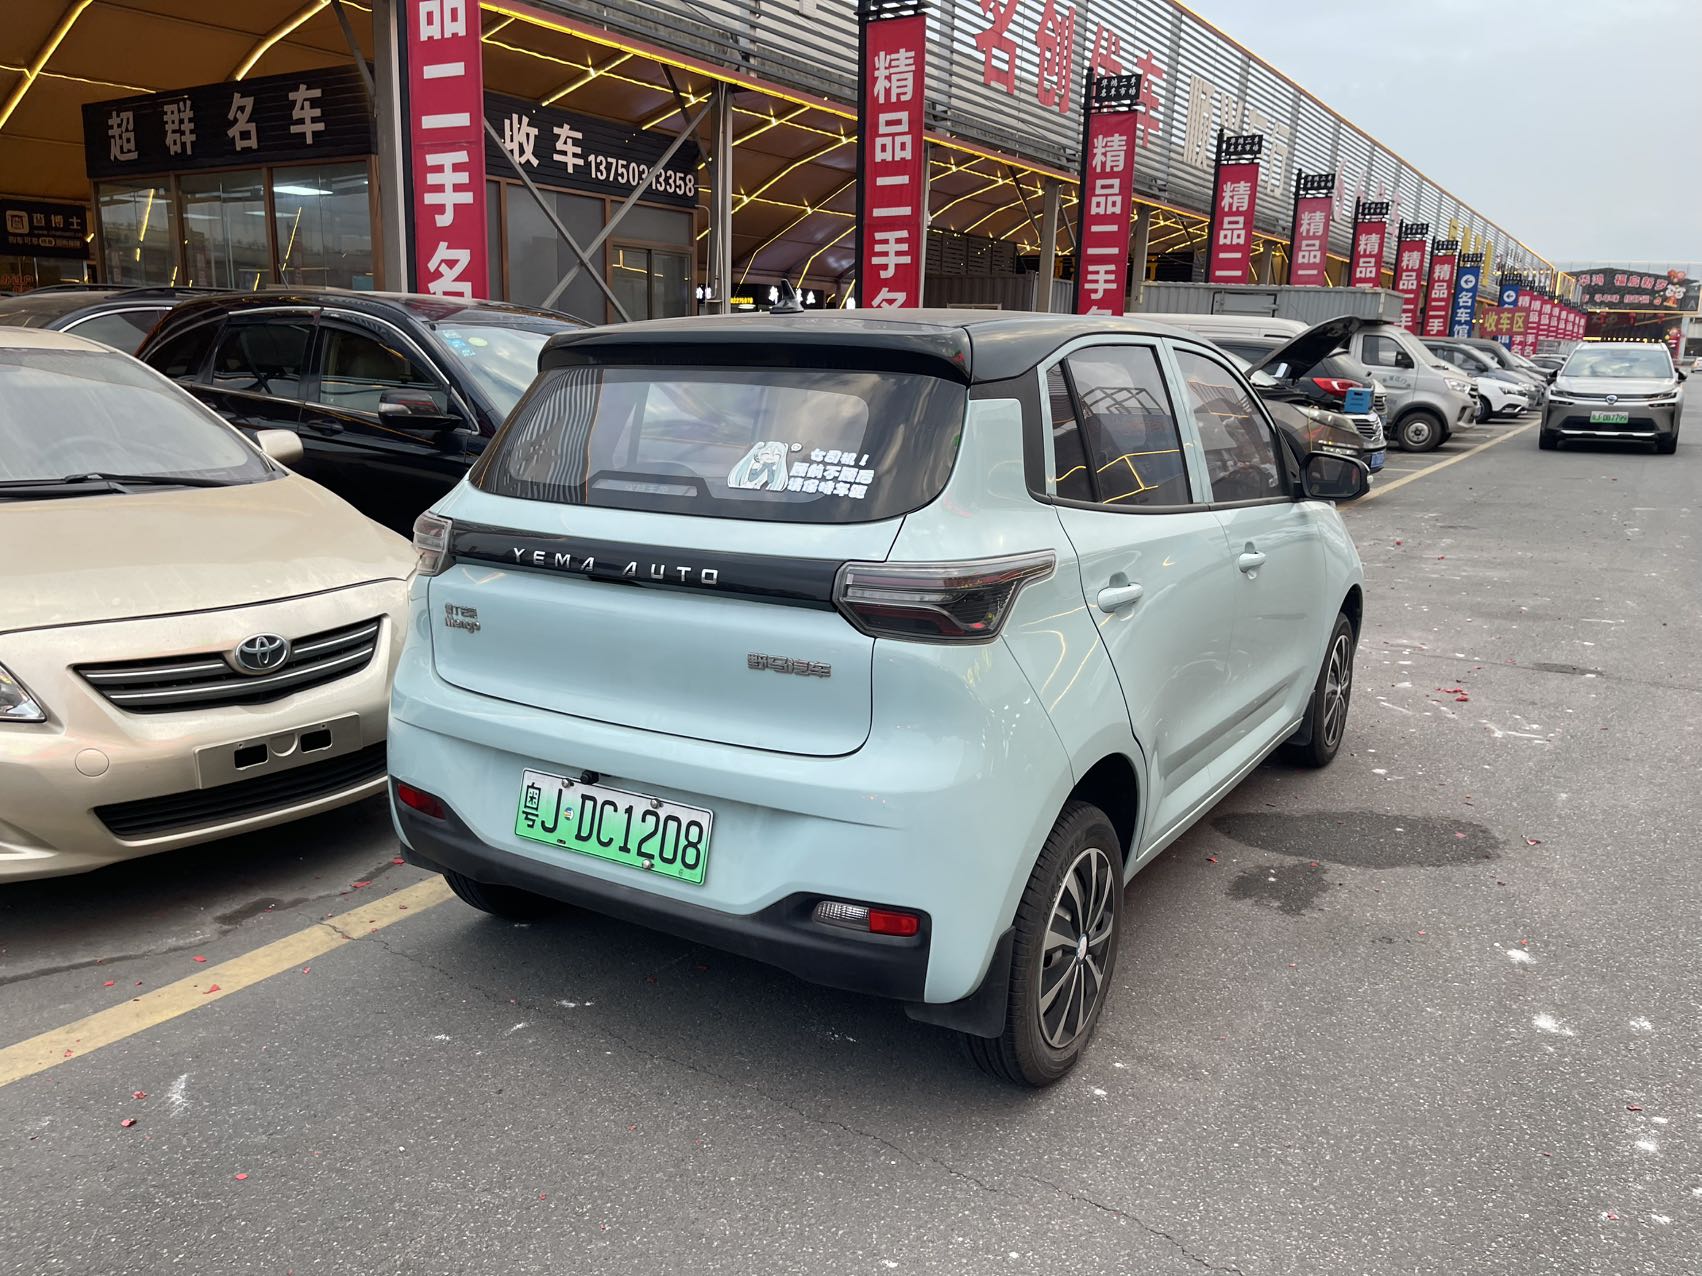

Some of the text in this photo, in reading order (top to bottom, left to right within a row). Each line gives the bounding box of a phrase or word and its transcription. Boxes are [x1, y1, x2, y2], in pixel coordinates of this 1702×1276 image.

[107, 83, 326, 162] 超群名车
[504, 113, 585, 174] 收车
[1084, 133, 1128, 316] 精品二手
[1215, 181, 1251, 276] 精品二
[1427, 264, 1452, 335] 精品二手
[1484, 311, 1526, 332] 收车区
[513, 547, 719, 585] YEMA AUTO
[747, 652, 832, 679] 野马汽车
